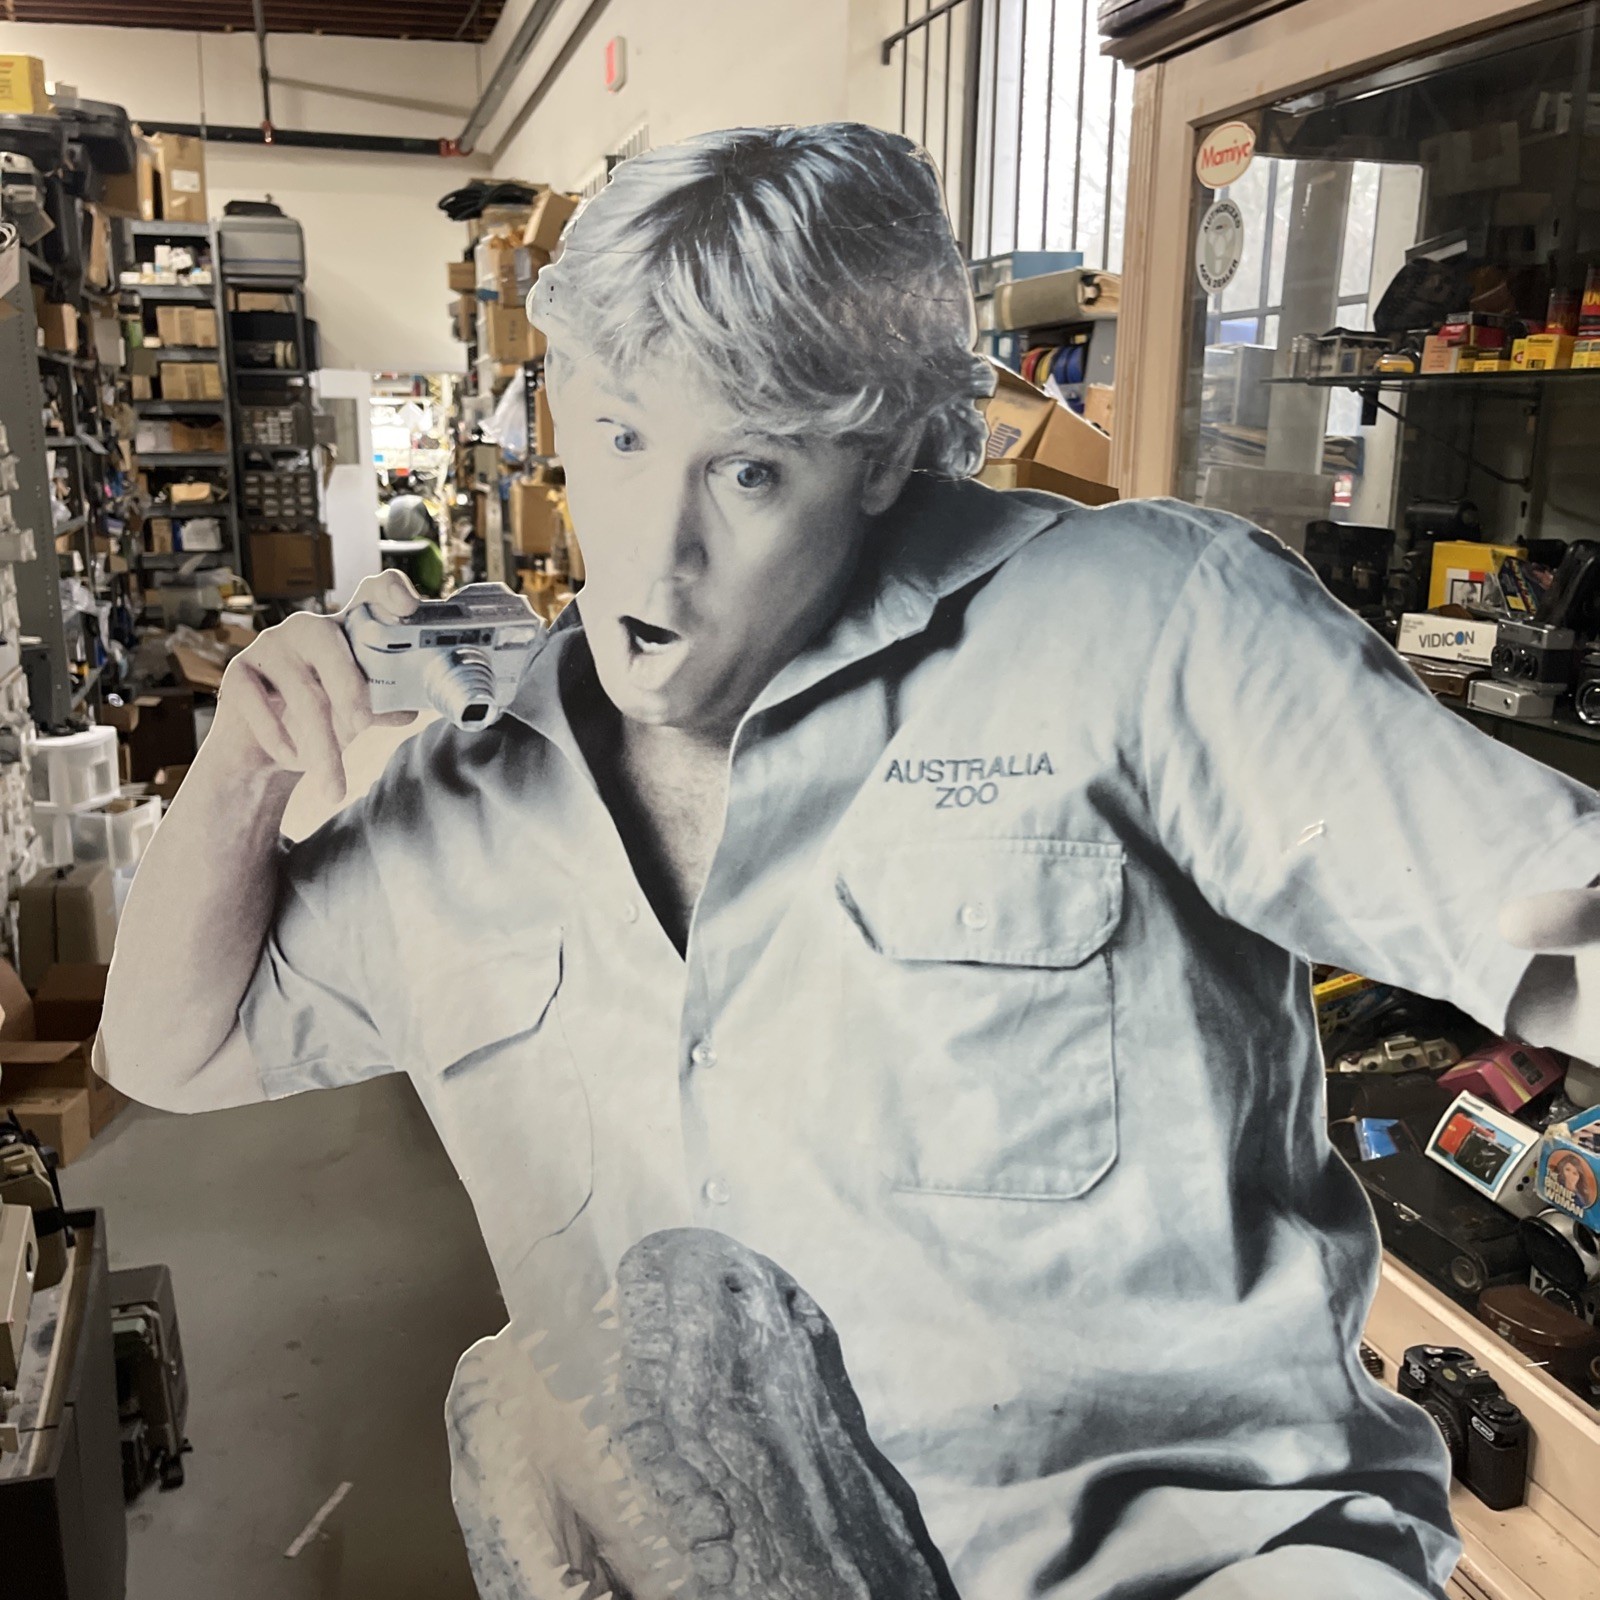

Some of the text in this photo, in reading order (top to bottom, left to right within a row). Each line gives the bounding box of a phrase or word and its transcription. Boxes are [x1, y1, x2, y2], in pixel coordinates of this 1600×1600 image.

[1204, 203, 1241, 233] AUTHORIZED
[1213, 259, 1239, 288] DEALER
[1419, 630, 1475, 648] VIDICON
[1457, 652, 1490, 663] Panasonic
[885, 751, 1054, 783] AUSTRALIA
[935, 782, 999, 809] ZOO
[1544, 1176, 1576, 1203] BIONIC
[1544, 1187, 1584, 1218] WOMAN
